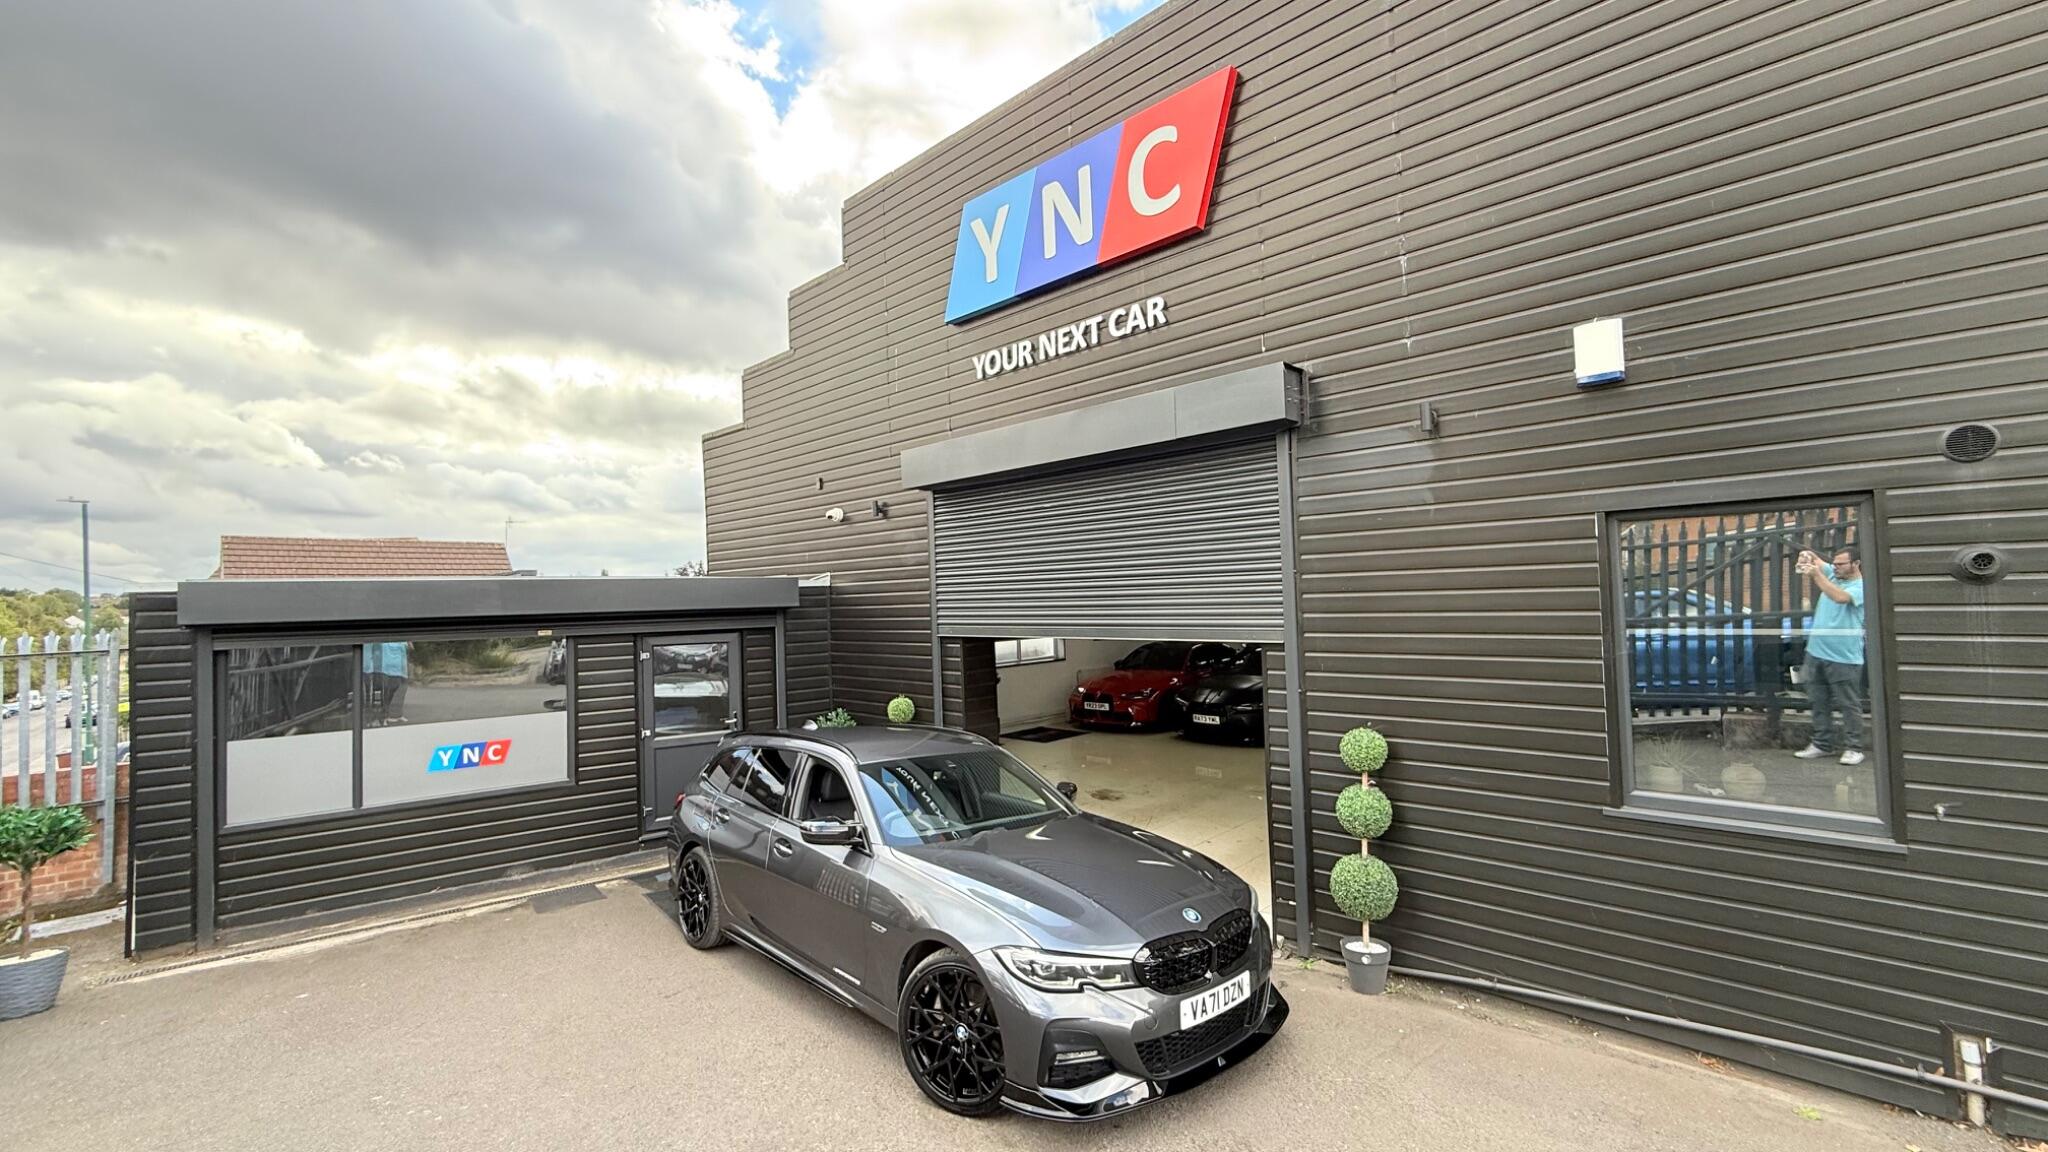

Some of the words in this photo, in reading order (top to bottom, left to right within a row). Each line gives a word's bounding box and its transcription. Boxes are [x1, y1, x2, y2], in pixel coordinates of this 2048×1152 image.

[969, 125, 1182, 284] YNC
[971, 339, 1034, 381] YOUR
[1038, 314, 1103, 361] NEXT
[1107, 295, 1167, 338] CAR
[437, 744, 502, 767] YNC
[1190, 989, 1220, 1021] VA71
[1223, 977, 1244, 1007] DZN
